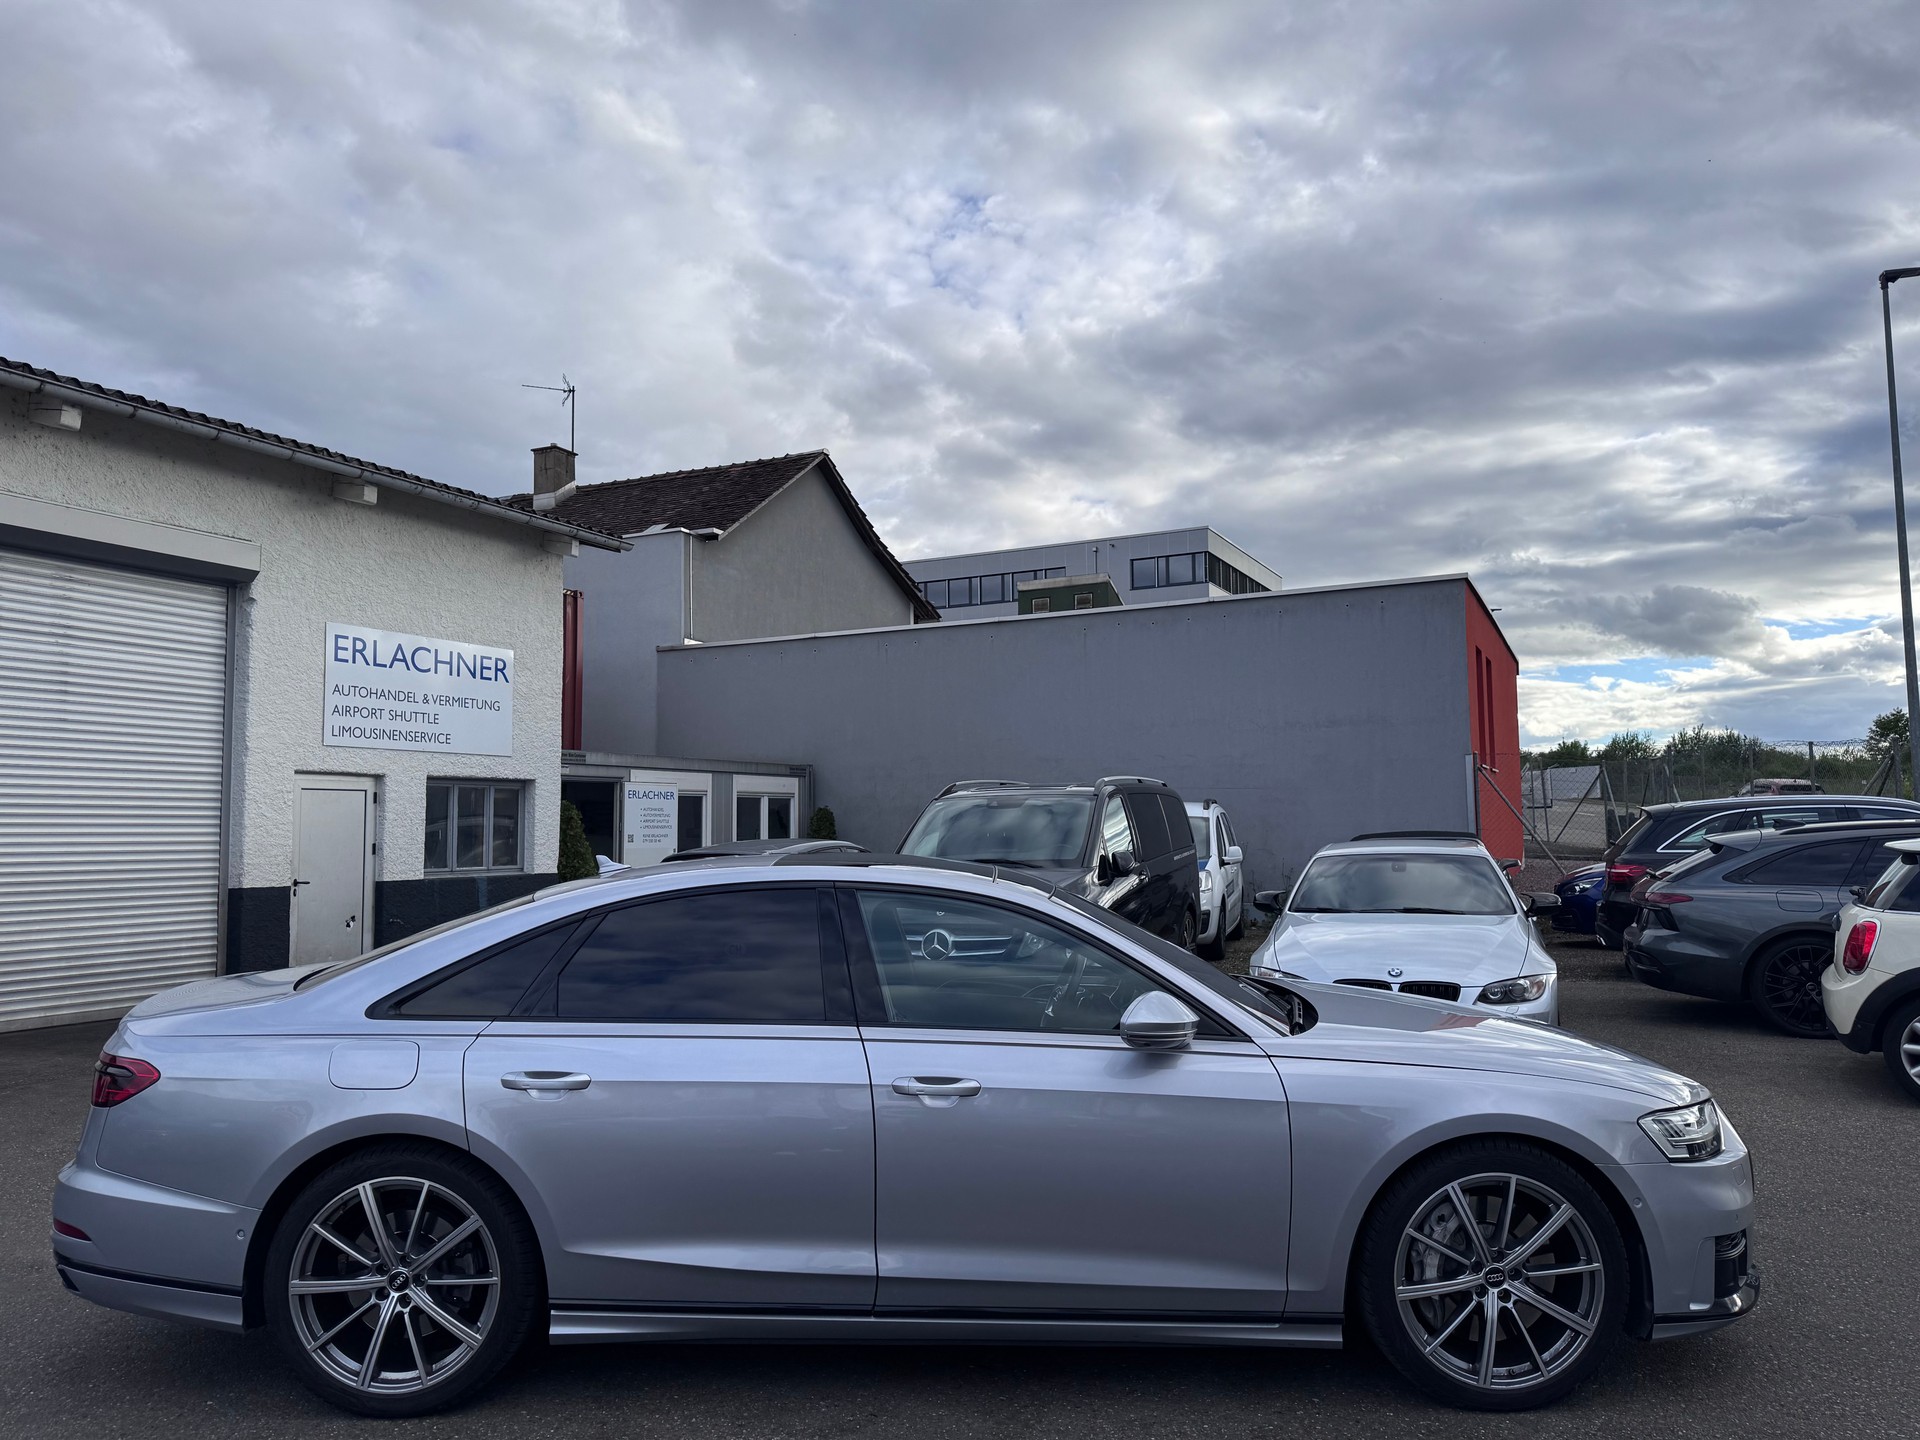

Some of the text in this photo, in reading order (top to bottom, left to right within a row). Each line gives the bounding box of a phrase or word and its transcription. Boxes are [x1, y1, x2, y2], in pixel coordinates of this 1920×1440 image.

[333, 633, 510, 683] ERLACHNER
[332, 683, 501, 712] AUTOHANDEL & VERMIETUNG
[331, 704, 440, 725] AIRPORT SHUTTLE
[331, 725, 451, 745] LIMOUSINENSERVICE
[627, 789, 675, 800] ERLACHNER
